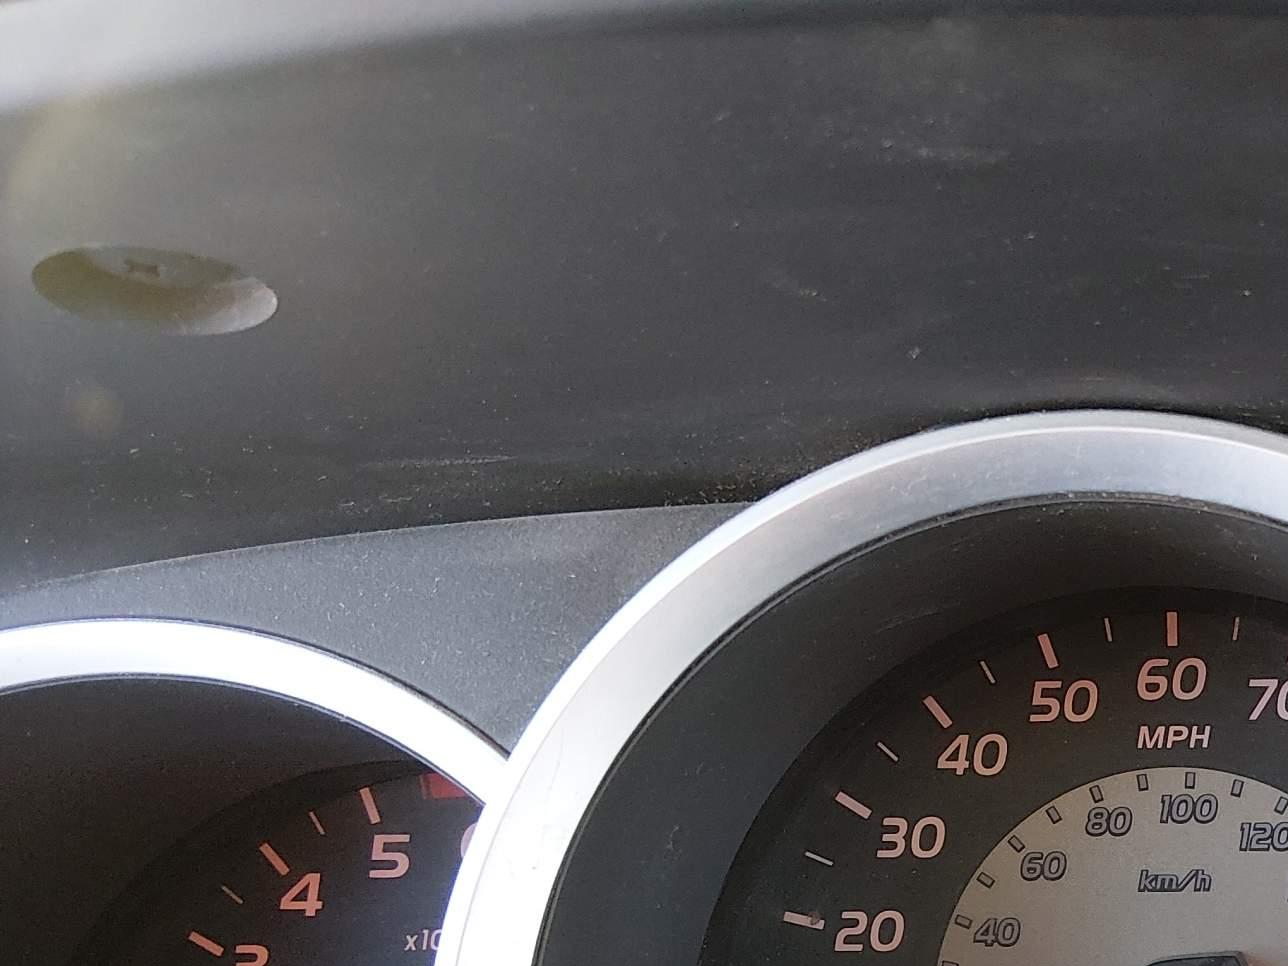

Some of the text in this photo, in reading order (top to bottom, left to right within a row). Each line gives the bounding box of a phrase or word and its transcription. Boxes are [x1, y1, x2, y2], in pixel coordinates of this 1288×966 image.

[1136, 657, 1208, 701] 60
[1029, 679, 1099, 723] 50
[936, 733, 1009, 776] 40
[1136, 725, 1211, 749] MPH
[1085, 806, 1133, 836] 80
[1160, 794, 1219, 824] 100
[368, 834, 411, 879] 5
[876, 816, 947, 859] 30
[1020, 851, 1067, 881] 60
[1138, 869, 1212, 893] km/h
[279, 872, 324, 917] 4
[834, 909, 906, 952] 20
[973, 917, 1021, 947] 40
